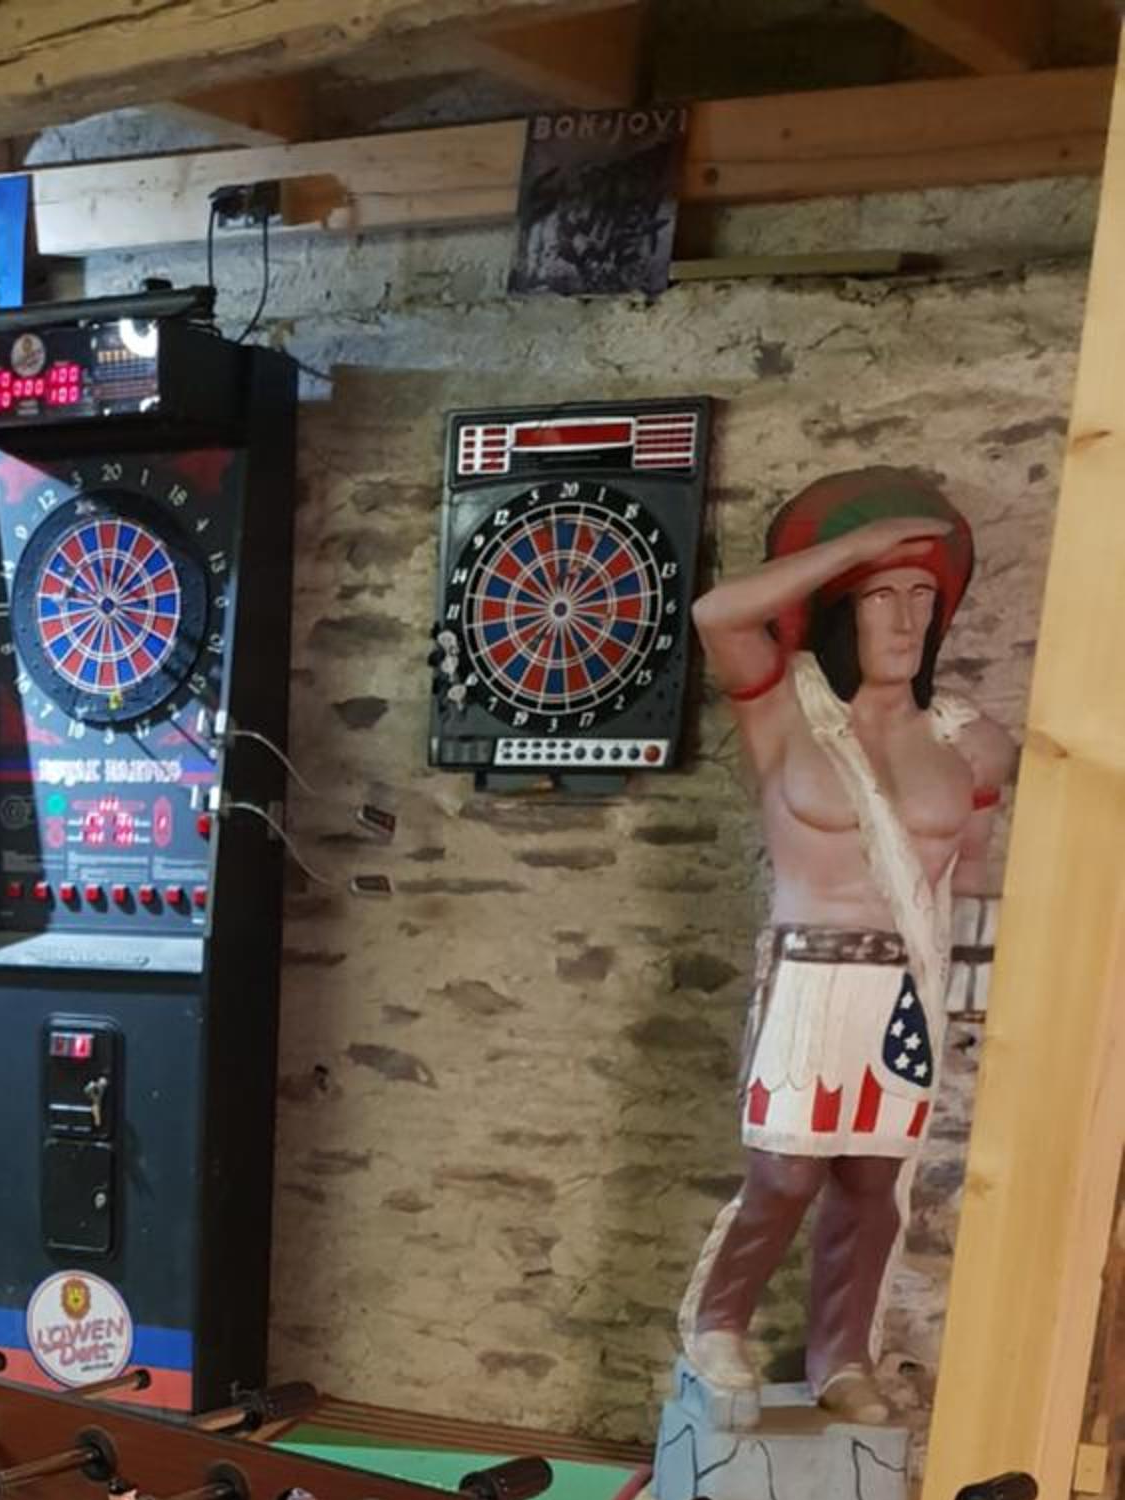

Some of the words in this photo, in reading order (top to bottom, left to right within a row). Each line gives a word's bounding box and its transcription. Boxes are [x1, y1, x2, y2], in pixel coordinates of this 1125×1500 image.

[102, 463, 122, 482] 20
[528, 489, 540, 505] 5
[559, 481, 579, 499] 20
[597, 487, 607, 502] 1
[38, 489, 58, 511] 12
[493, 510, 510, 525] 12
[452, 568, 468, 585] 14
[662, 563, 677, 579] 13
[447, 604, 461, 619] 11
[666, 601, 676, 615] 6
[655, 634, 673, 650] 10
[635, 669, 652, 686] 15
[614, 695, 625, 710] 2
[547, 717, 559, 733] 3
[579, 711, 595, 728] 17
